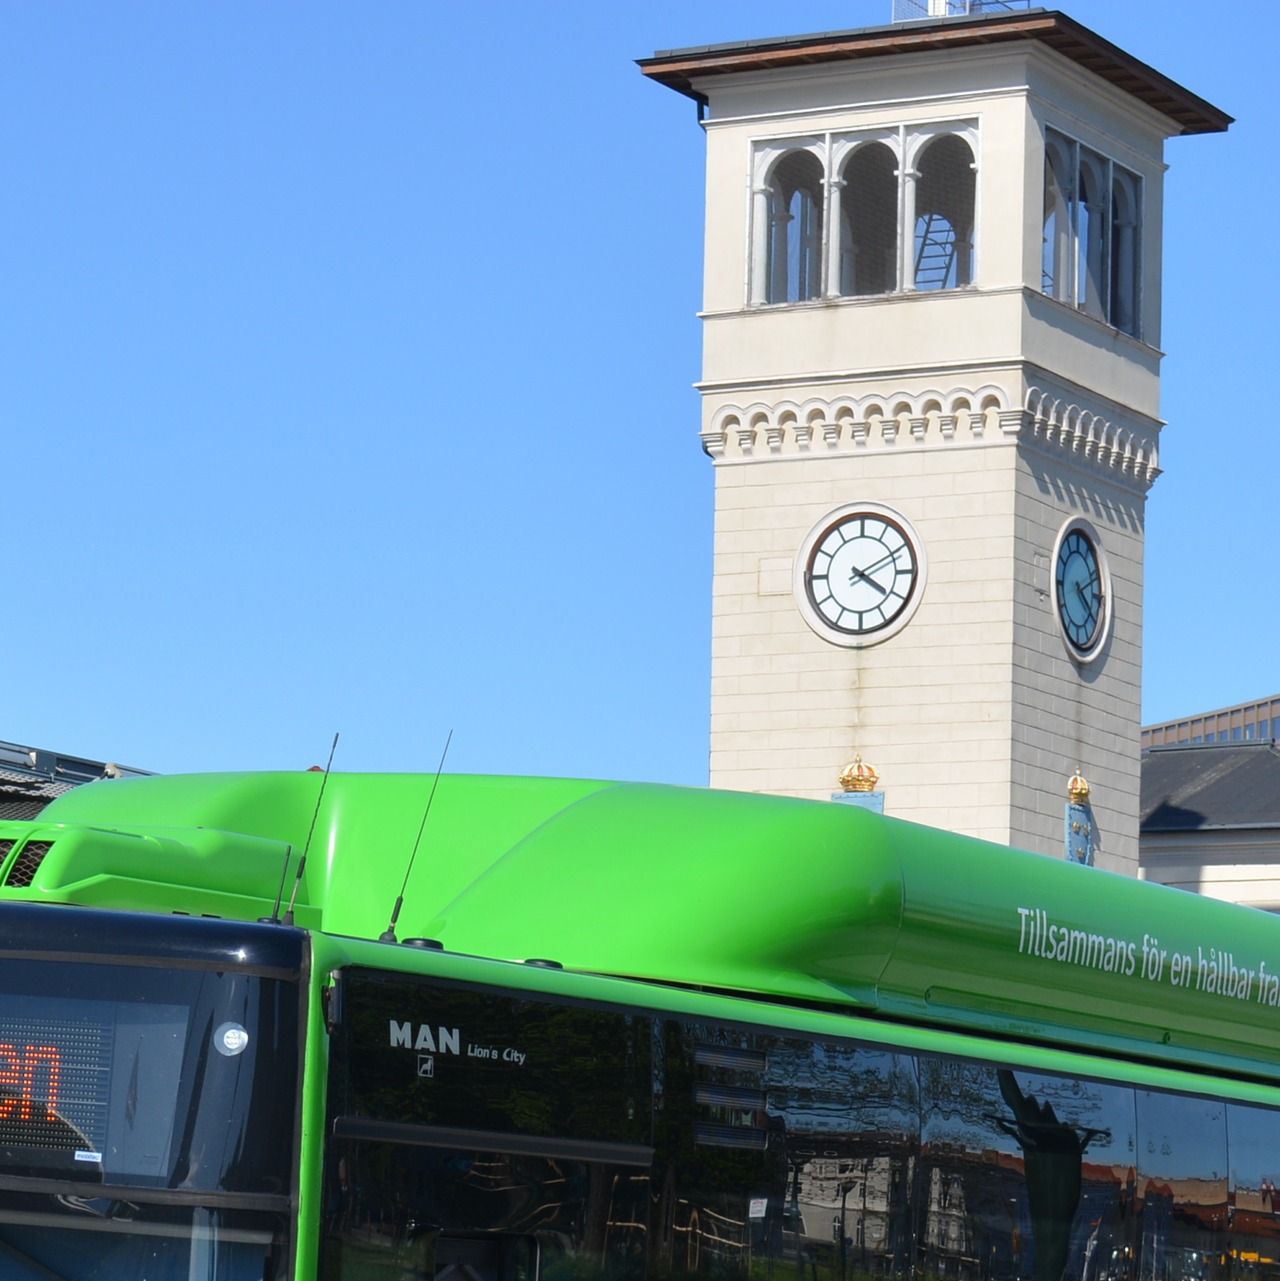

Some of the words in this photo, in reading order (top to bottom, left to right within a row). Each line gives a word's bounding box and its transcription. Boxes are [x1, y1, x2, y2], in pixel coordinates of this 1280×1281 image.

[1017, 906, 1136, 976] Tillsammans
[1141, 933, 1168, 983] för
[1170, 951, 1192, 988] en
[1195, 945, 1256, 1001] hållbar
[389, 1019, 460, 1055] MAN
[467, 1043, 499, 1060] Lion's
[502, 1047, 526, 1065] City
